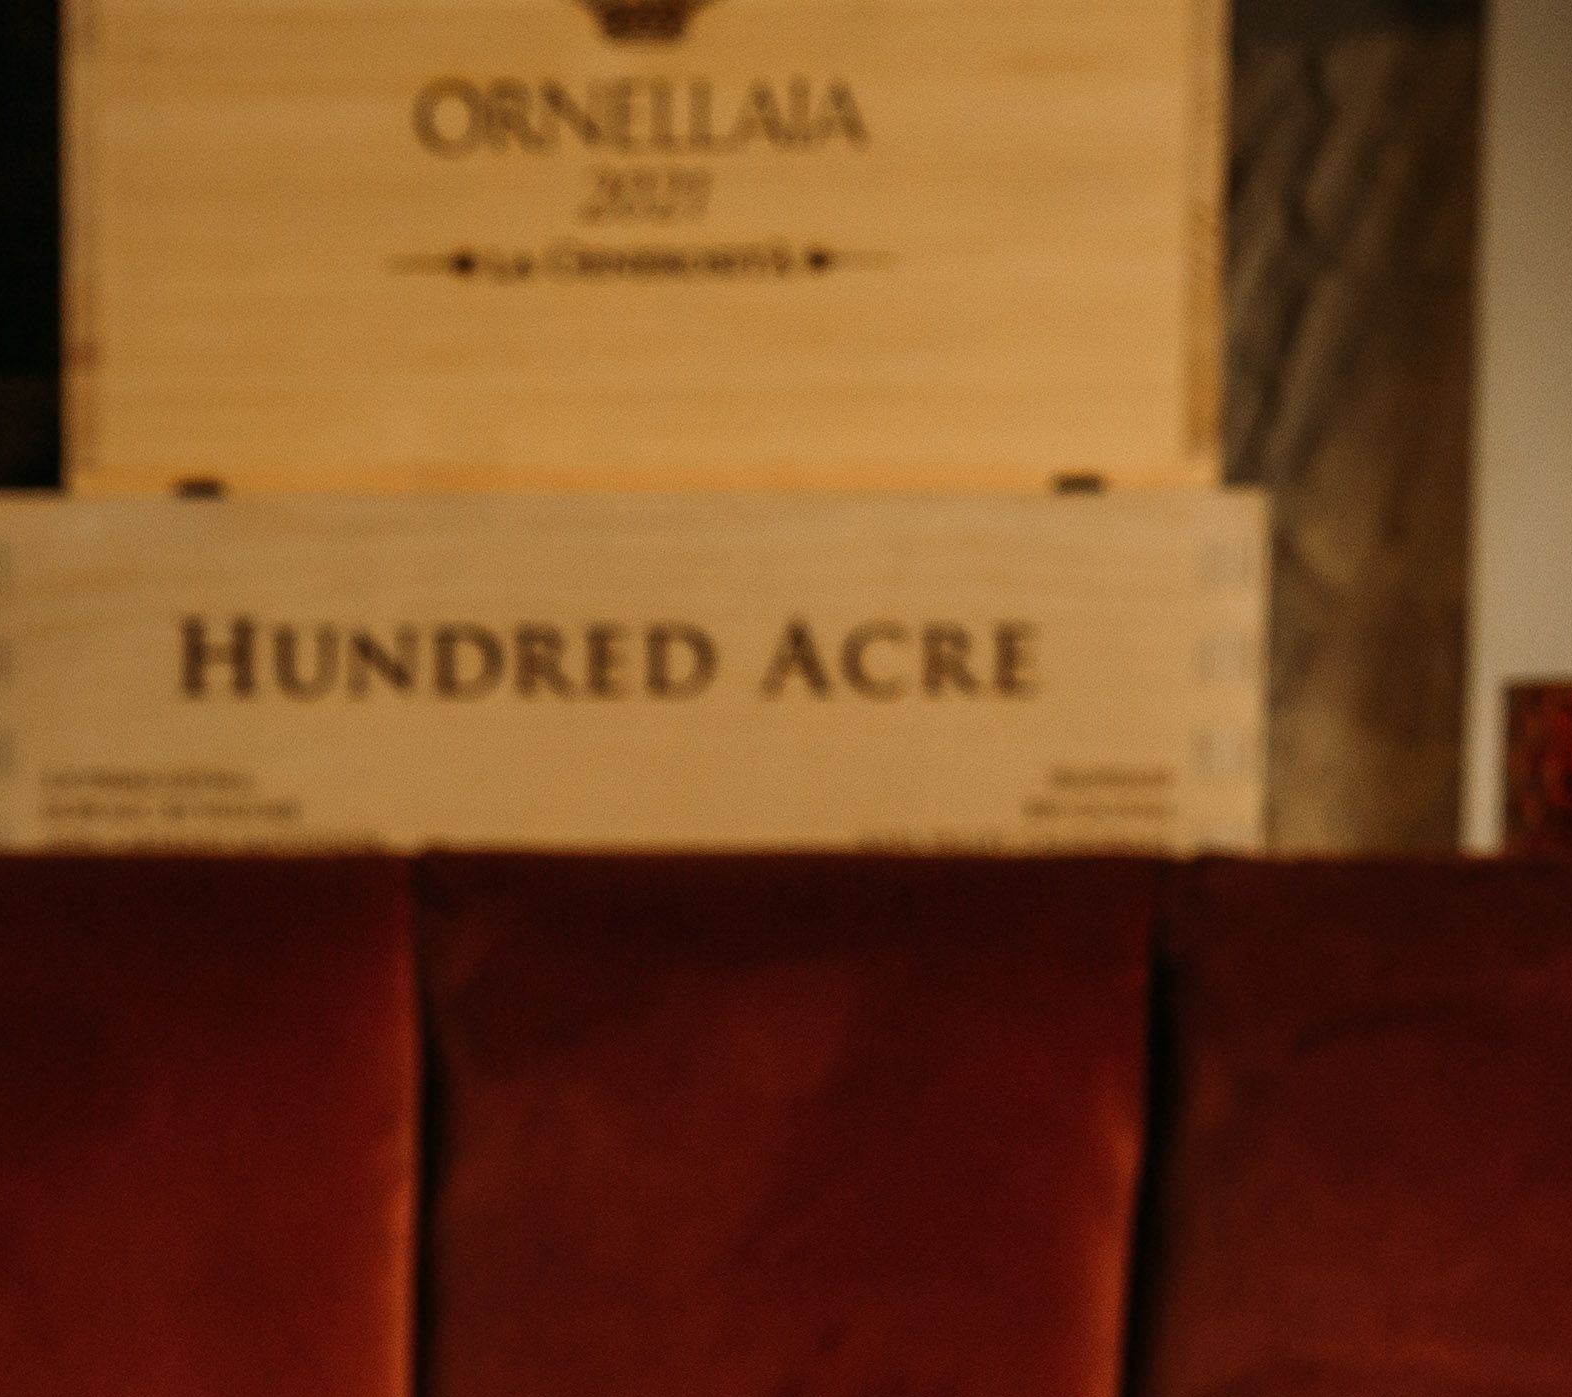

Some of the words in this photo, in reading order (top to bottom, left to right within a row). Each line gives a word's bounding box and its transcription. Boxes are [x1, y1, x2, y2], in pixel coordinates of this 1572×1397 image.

[410, 75, 872, 159] ORNELLAIA
[178, 612, 720, 703] HUNDRED
[756, 614, 1045, 703] ACRE
